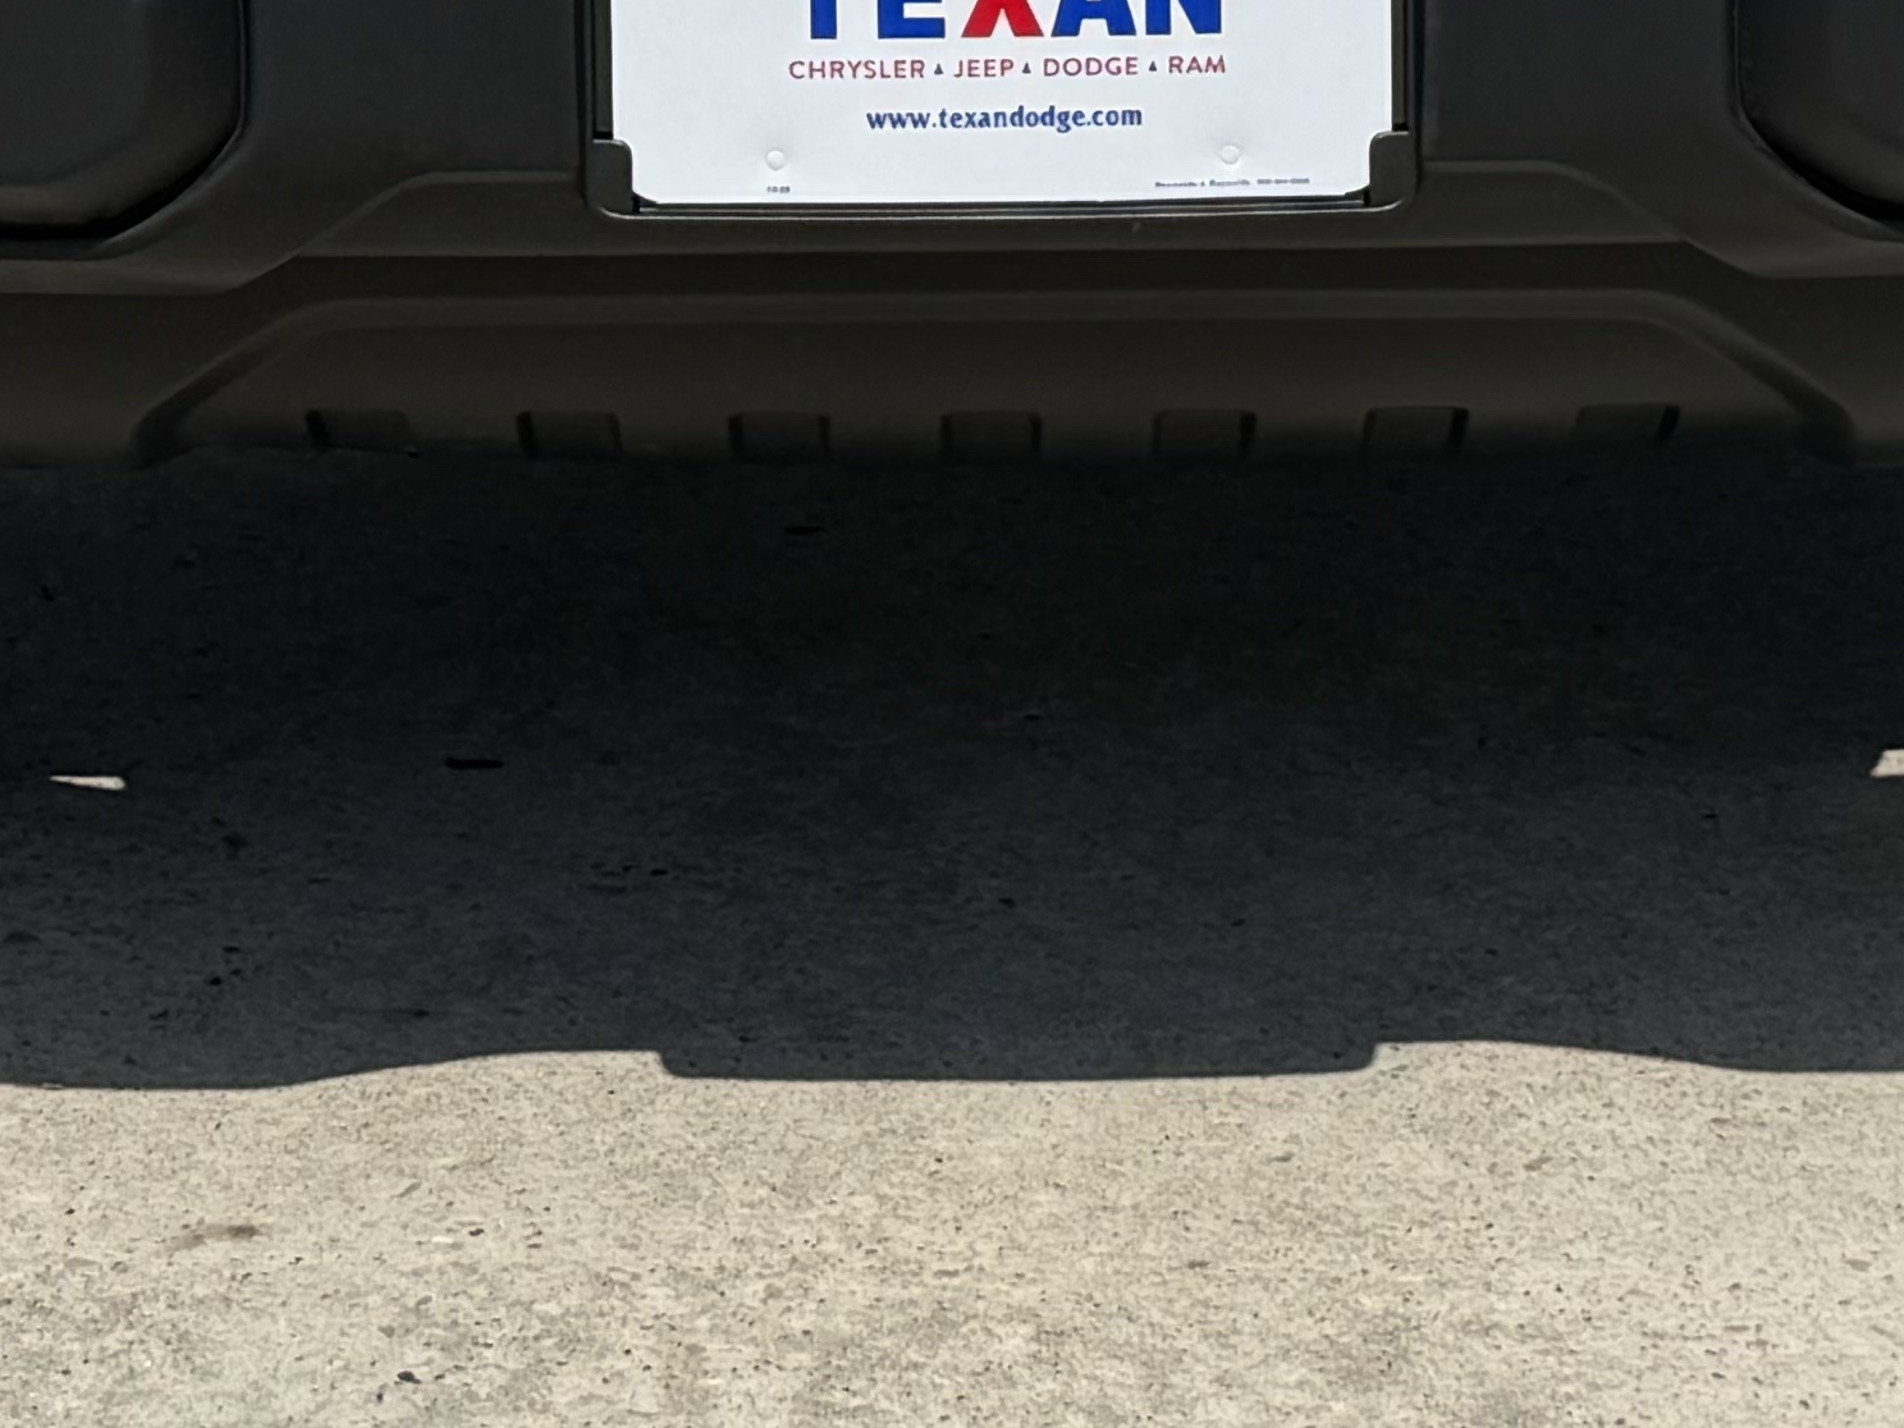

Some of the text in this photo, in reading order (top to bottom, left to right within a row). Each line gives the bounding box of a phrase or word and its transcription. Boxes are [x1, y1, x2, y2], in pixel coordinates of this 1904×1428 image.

[788, 54, 1226, 80] CHRYSLER JEEP DODGE RAM
[866, 104, 1143, 134] www.texandodge.com
